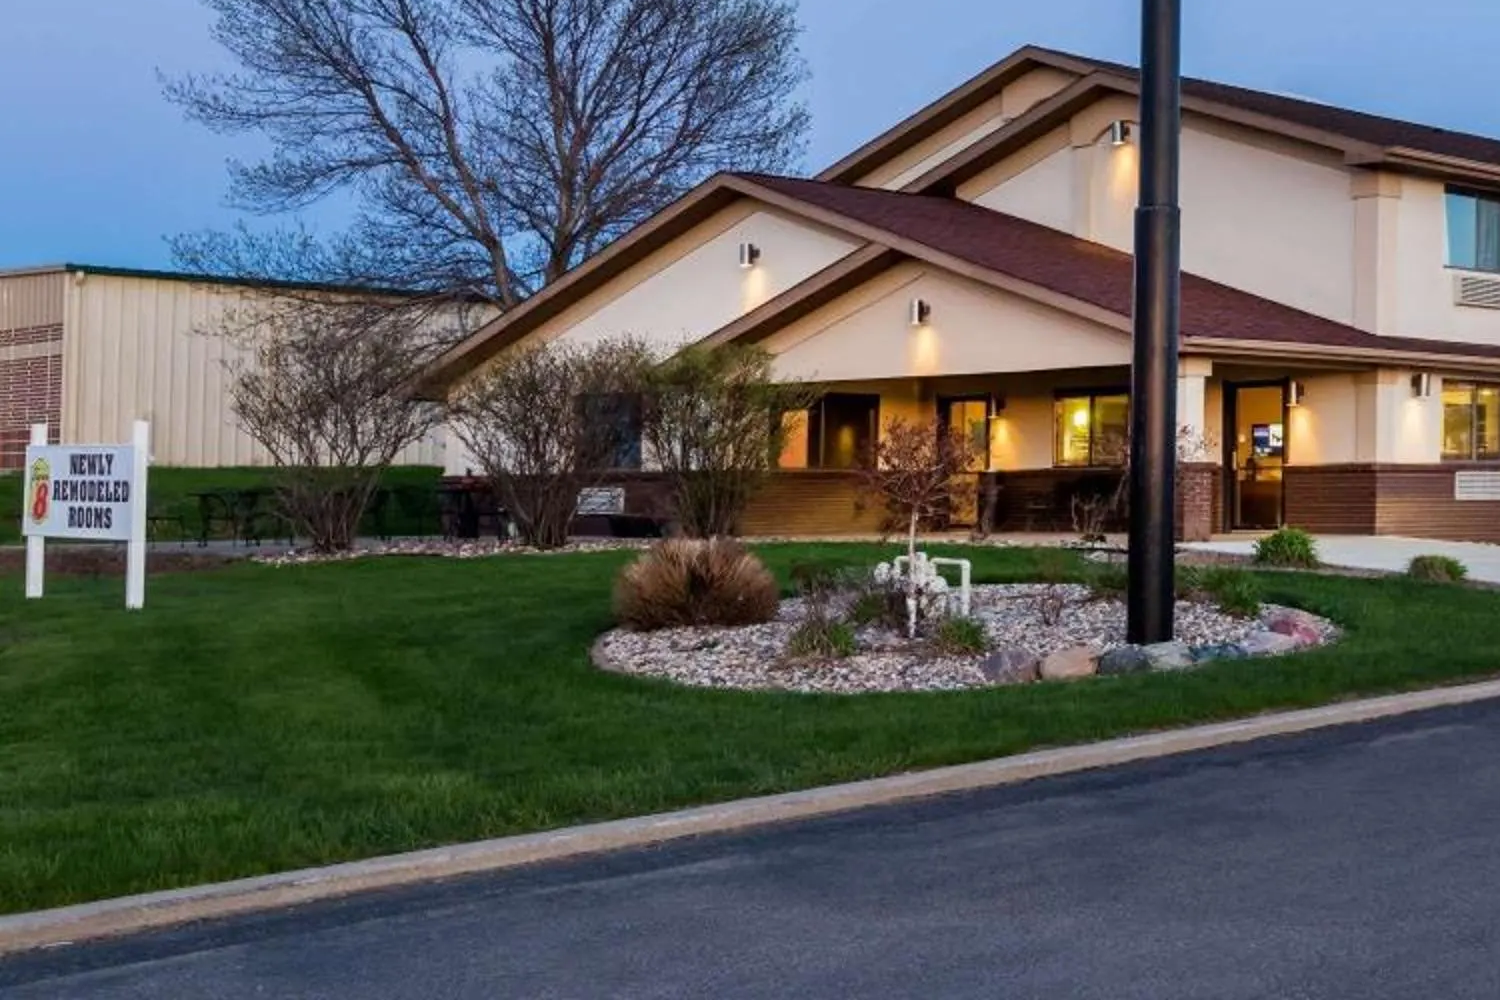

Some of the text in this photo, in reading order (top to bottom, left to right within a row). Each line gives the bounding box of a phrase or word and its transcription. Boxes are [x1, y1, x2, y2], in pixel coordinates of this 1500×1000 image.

[70, 453, 114, 476] NEWLY
[32, 482, 49, 520] 8
[52, 480, 130, 503] REMODELED
[67, 506, 113, 529] ROOMS
